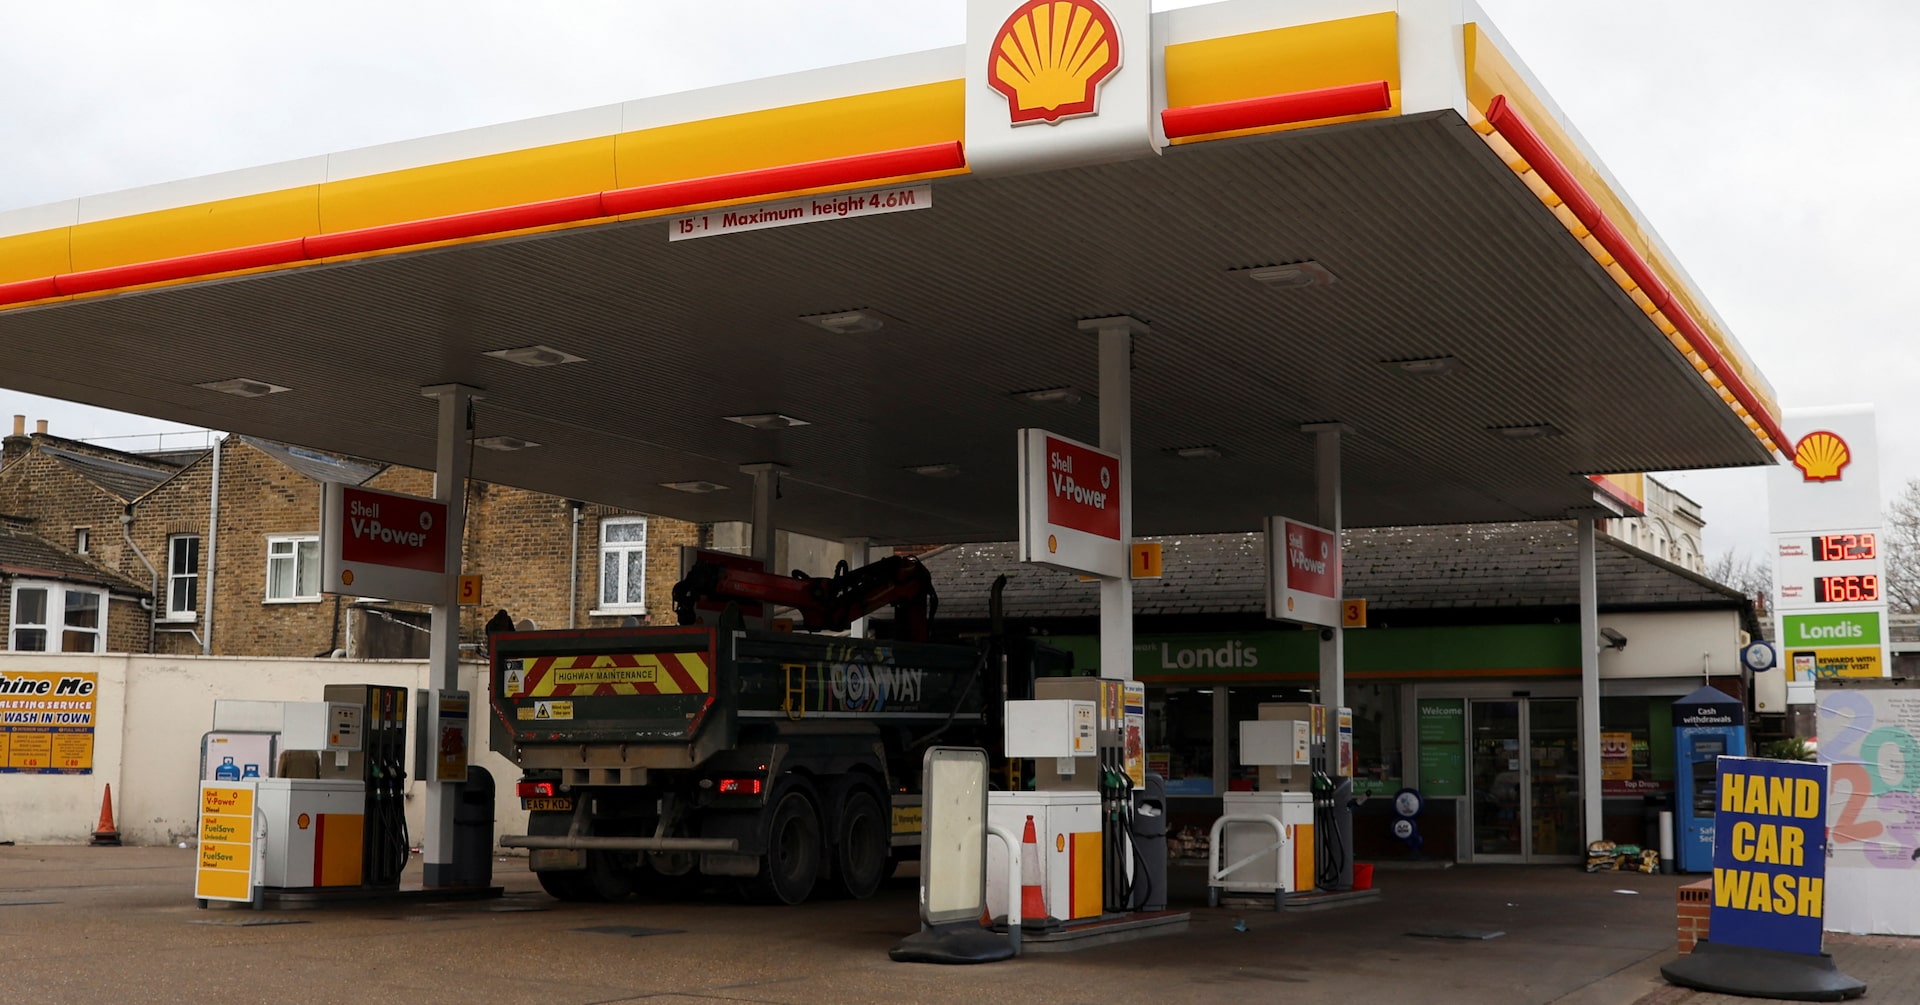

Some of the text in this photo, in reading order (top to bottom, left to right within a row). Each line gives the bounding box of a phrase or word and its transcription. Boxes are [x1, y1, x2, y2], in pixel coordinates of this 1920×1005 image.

[722, 207, 804, 229] Maximum
[811, 196, 865, 217] height
[868, 189, 916, 208] 4.6M
[1051, 451, 1073, 474] Shell
[1051, 471, 1107, 510] V-Power
[350, 500, 380, 519] Shell
[350, 516, 427, 548] V-Power
[1288, 532, 1304, 550] Shell
[1820, 533, 1876, 561] 152.9
[1141, 551, 1149, 570] 1
[1289, 547, 1326, 576] V-Power
[463, 581, 473, 598] 5
[1822, 575, 1879, 602] 166.9
[1347, 605, 1359, 621] 3
[1800, 621, 1863, 639] Londis
[1161, 639, 1259, 670] Londis
[1819, 656, 1854, 664] REWARDS
[558, 670, 653, 681] HIGHWAY MAINTENANCE
[829, 663, 924, 702] CONWAY
[55, 678, 94, 695] Me
[47, 701, 92, 711] SERVICE
[1421, 706, 1464, 715] Welcome
[1697, 707, 1717, 716] Cash
[4, 712, 91, 723] WASH IN TOWN
[1683, 715, 1732, 723] withdrawals
[206, 797, 235, 806] V-Power
[1721, 773, 1820, 819] HAND
[205, 824, 235, 833] FuelSave
[1731, 821, 1805, 867] CAR
[203, 851, 234, 861] FuelSave
[1713, 867, 1824, 918] WASH
